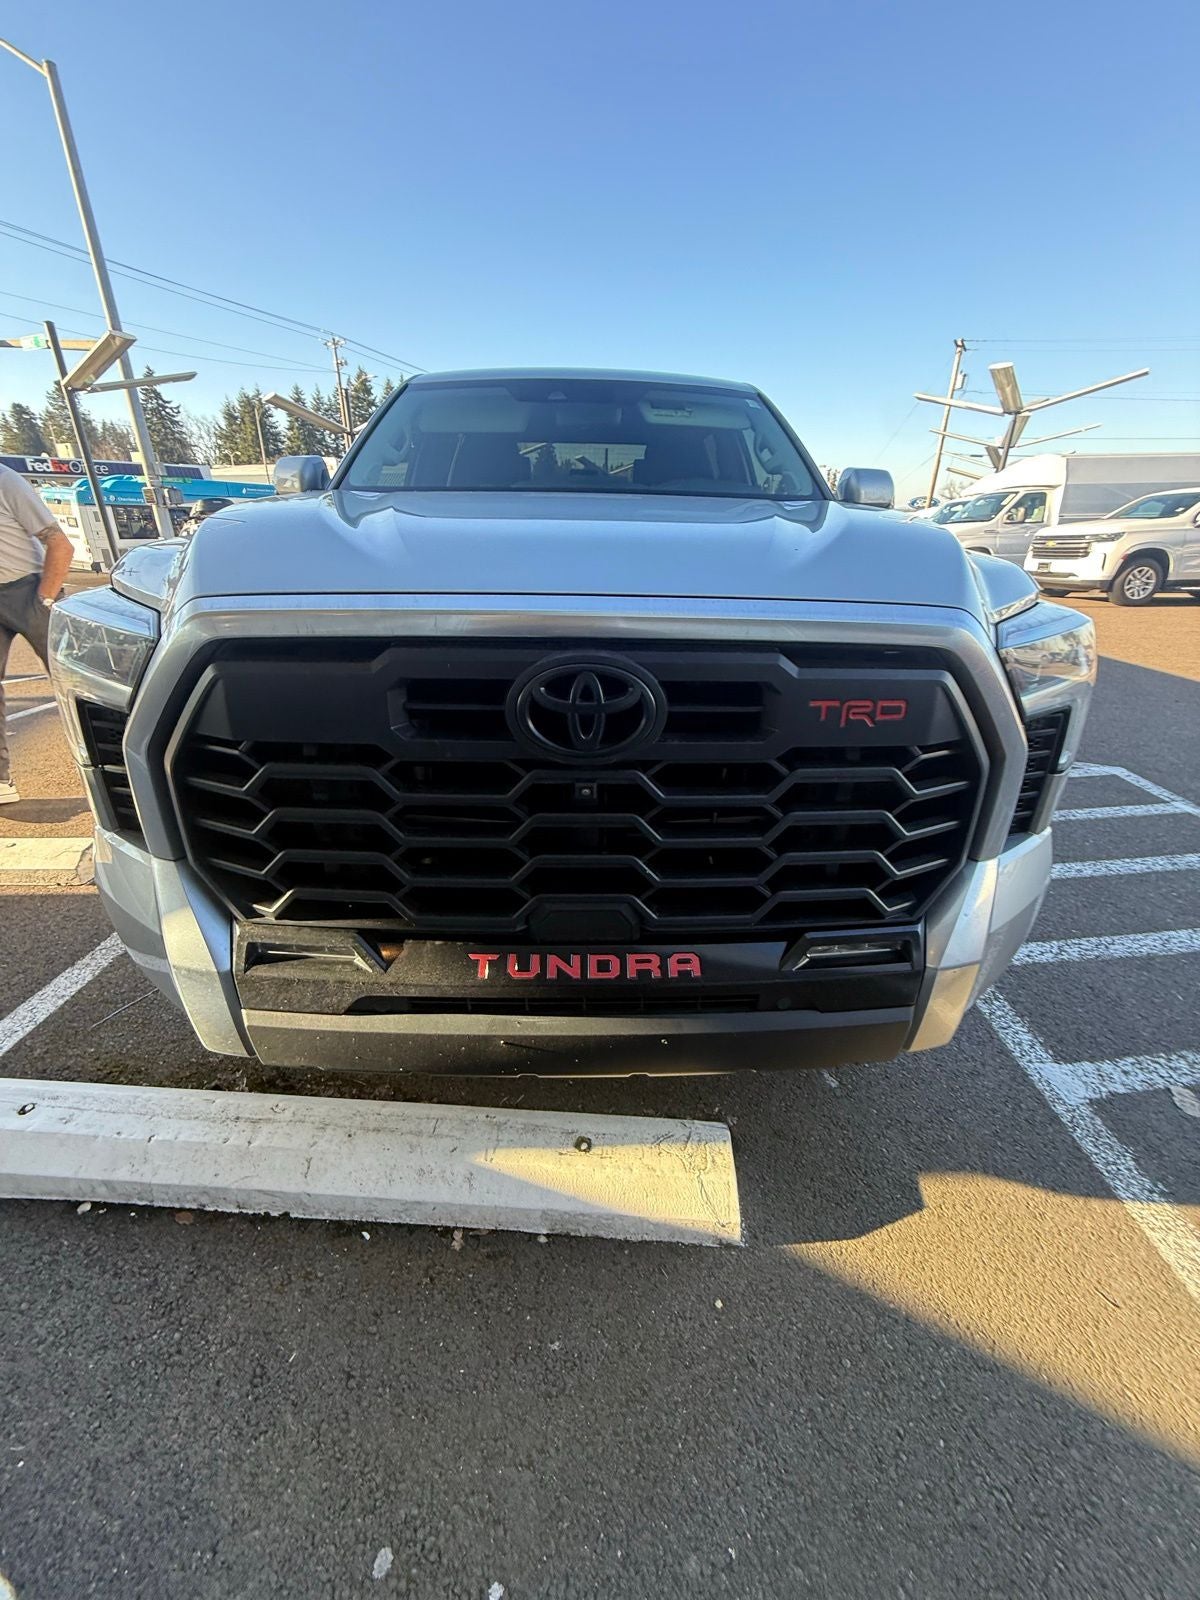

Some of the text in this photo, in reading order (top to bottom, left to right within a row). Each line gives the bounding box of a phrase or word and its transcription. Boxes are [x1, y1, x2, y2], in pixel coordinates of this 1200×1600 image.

[25, 457, 109, 474] FedEx Ofce
[808, 699, 907, 728] TRD
[467, 952, 702, 980] TUNDRA
